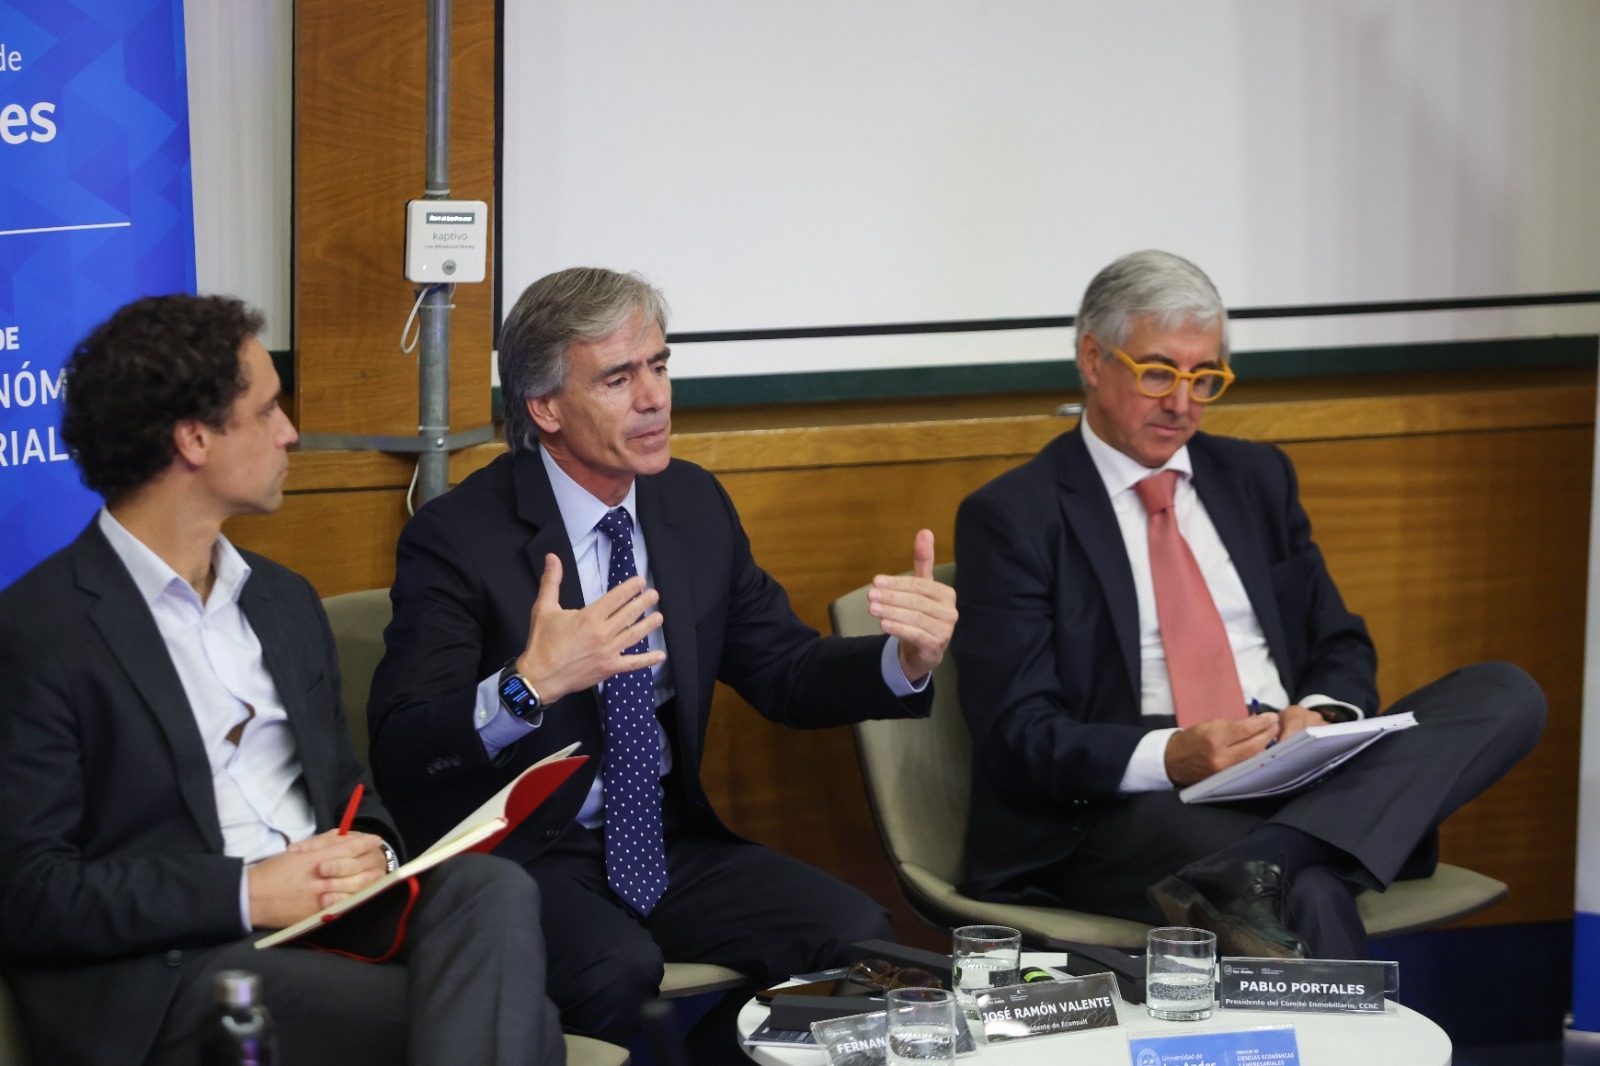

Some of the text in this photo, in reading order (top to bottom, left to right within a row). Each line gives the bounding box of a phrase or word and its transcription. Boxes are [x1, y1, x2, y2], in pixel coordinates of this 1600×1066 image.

[432, 230, 468, 242] kaptivo
[1240, 980, 1365, 995] PABLO PORTALES
[1225, 998, 1266, 1006] Presidente
[1309, 1001, 1357, 1009] Inmobiliario,
[982, 996, 1112, 1023] JOSÉ RAMÓN VALENTE
[1060, 1018, 1088, 1028] Econsult
[1161, 1053, 1195, 1061] Universidad
[1237, 1054, 1260, 1062] CIENCIAS
